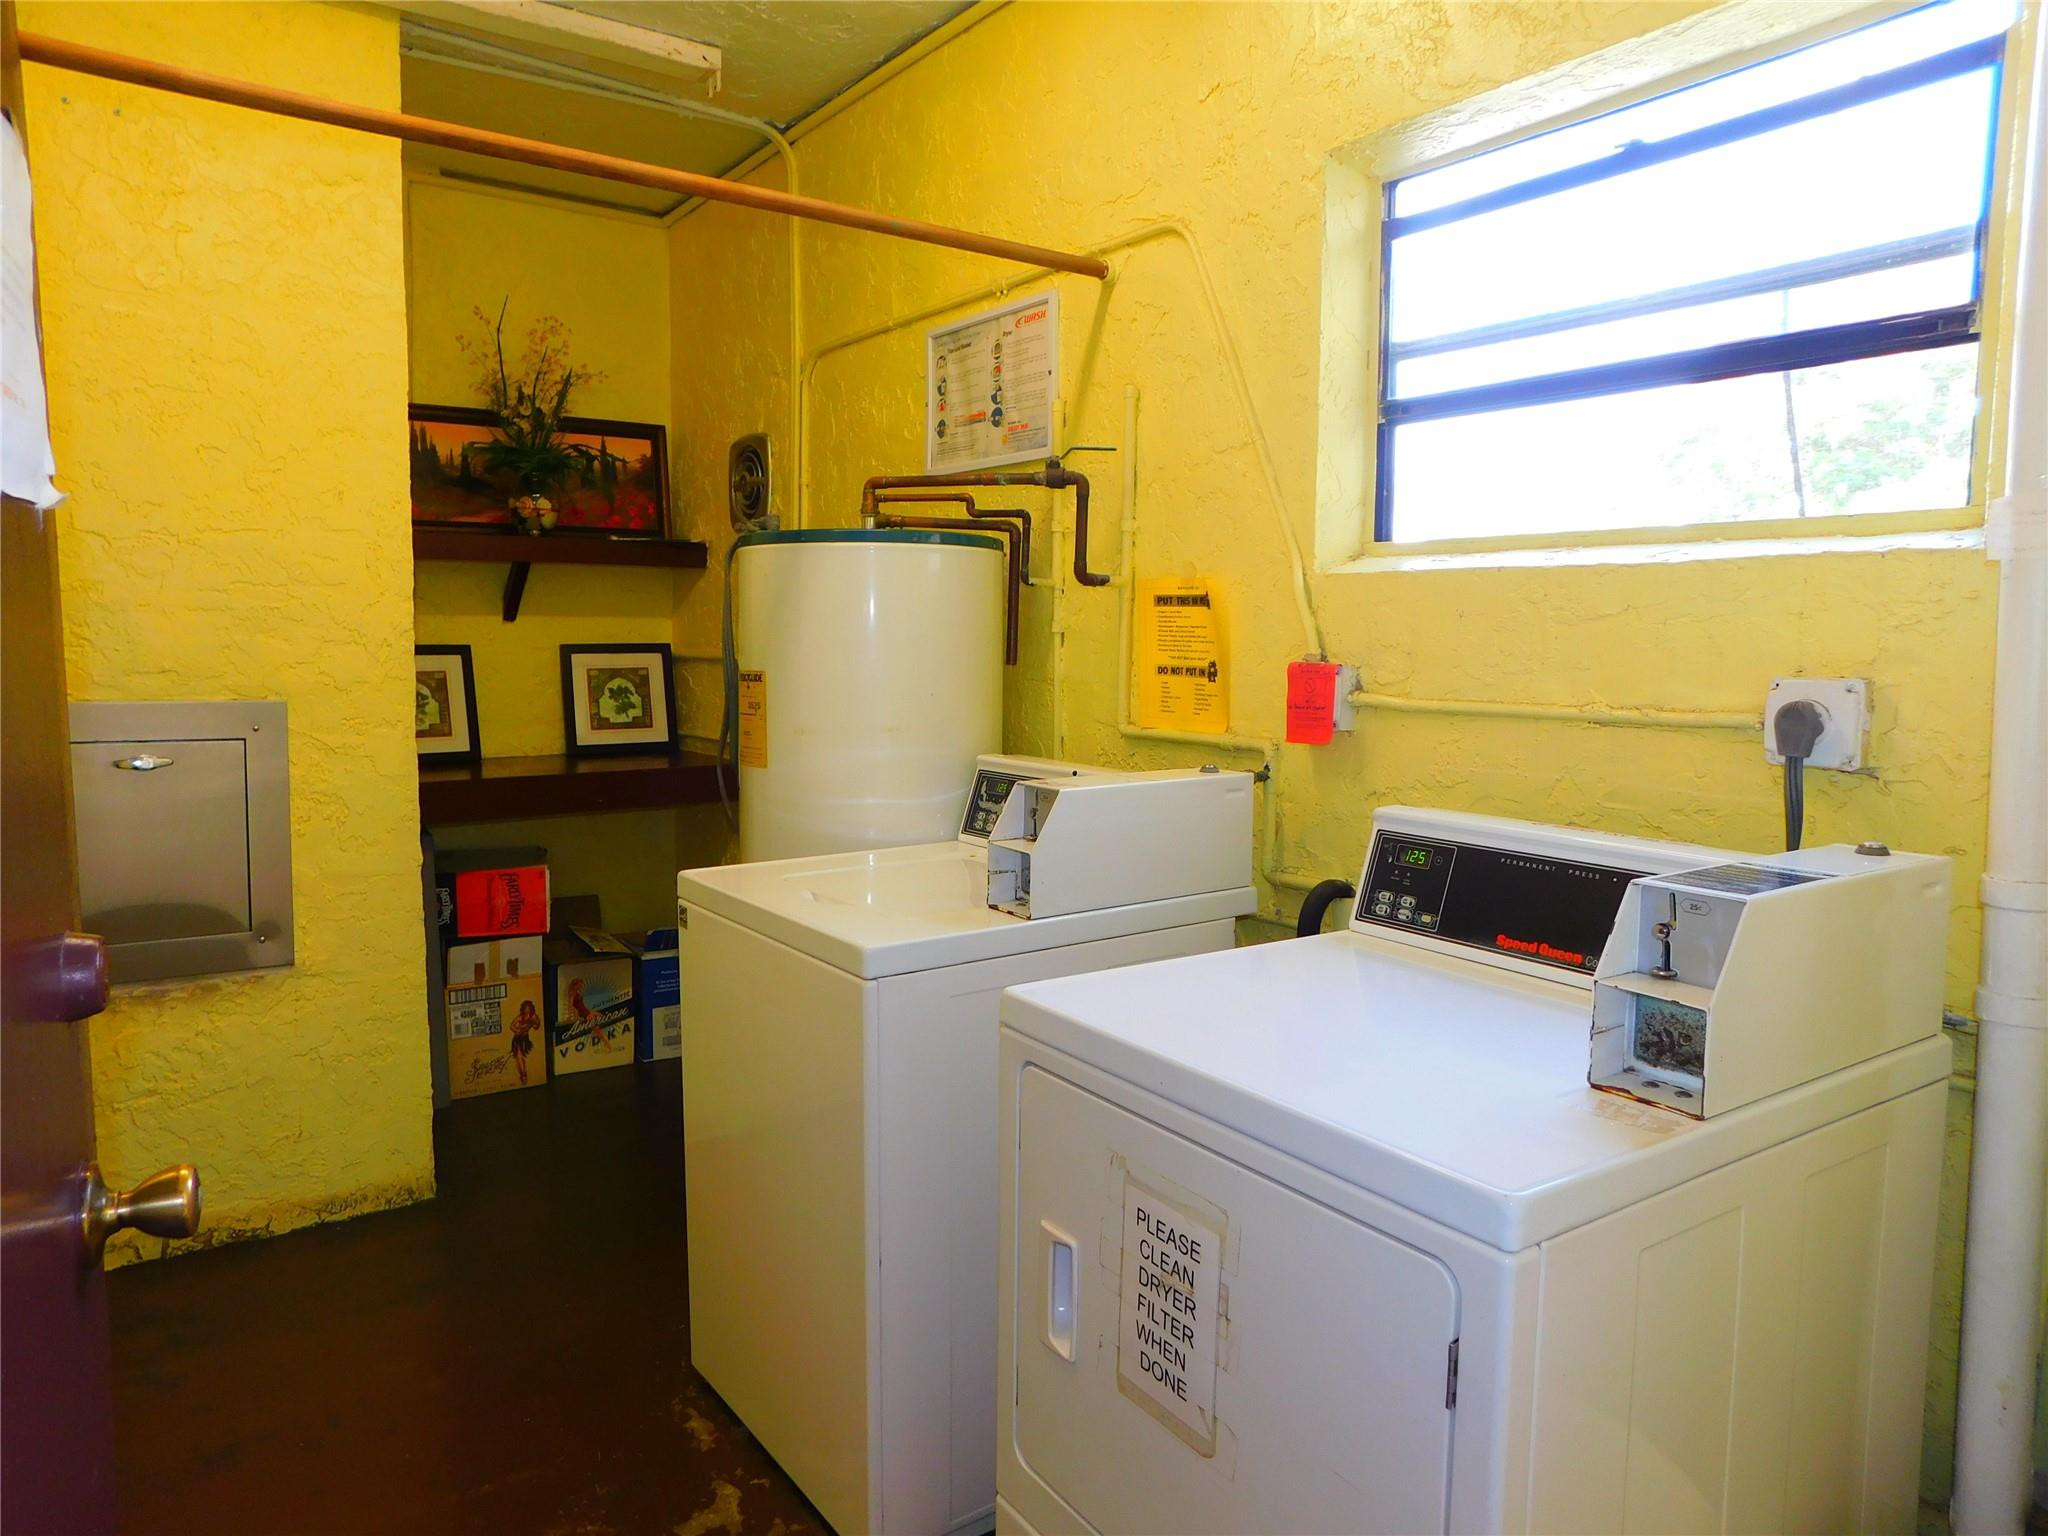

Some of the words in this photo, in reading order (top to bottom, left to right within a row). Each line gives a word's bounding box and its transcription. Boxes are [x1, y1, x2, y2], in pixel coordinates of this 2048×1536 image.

[1157, 596, 1173, 606] PUT
[1176, 596, 1190, 606] THIS
[1157, 666, 1169, 675] DO
[1170, 666, 1184, 676] NOT
[1185, 667, 1197, 677] PUT
[1198, 668, 1206, 677] IN
[1405, 849, 1426, 864] 125
[1500, 858, 1557, 873] PERMANENT
[1567, 868, 1601, 881] PRESS
[1495, 934, 1538, 955] Speed
[1538, 943, 1584, 966] Queen
[561, 1008, 631, 1039] American
[560, 1024, 631, 1058] VODKA
[1136, 1207, 1201, 1264] PLEASE
[1139, 1239, 1195, 1289] CLEAN
[1138, 1265, 1197, 1321] DRYER
[1137, 1293, 1194, 1349] FILTER
[1136, 1319, 1186, 1373] WHEN
[1140, 1351, 1188, 1402] DONE
